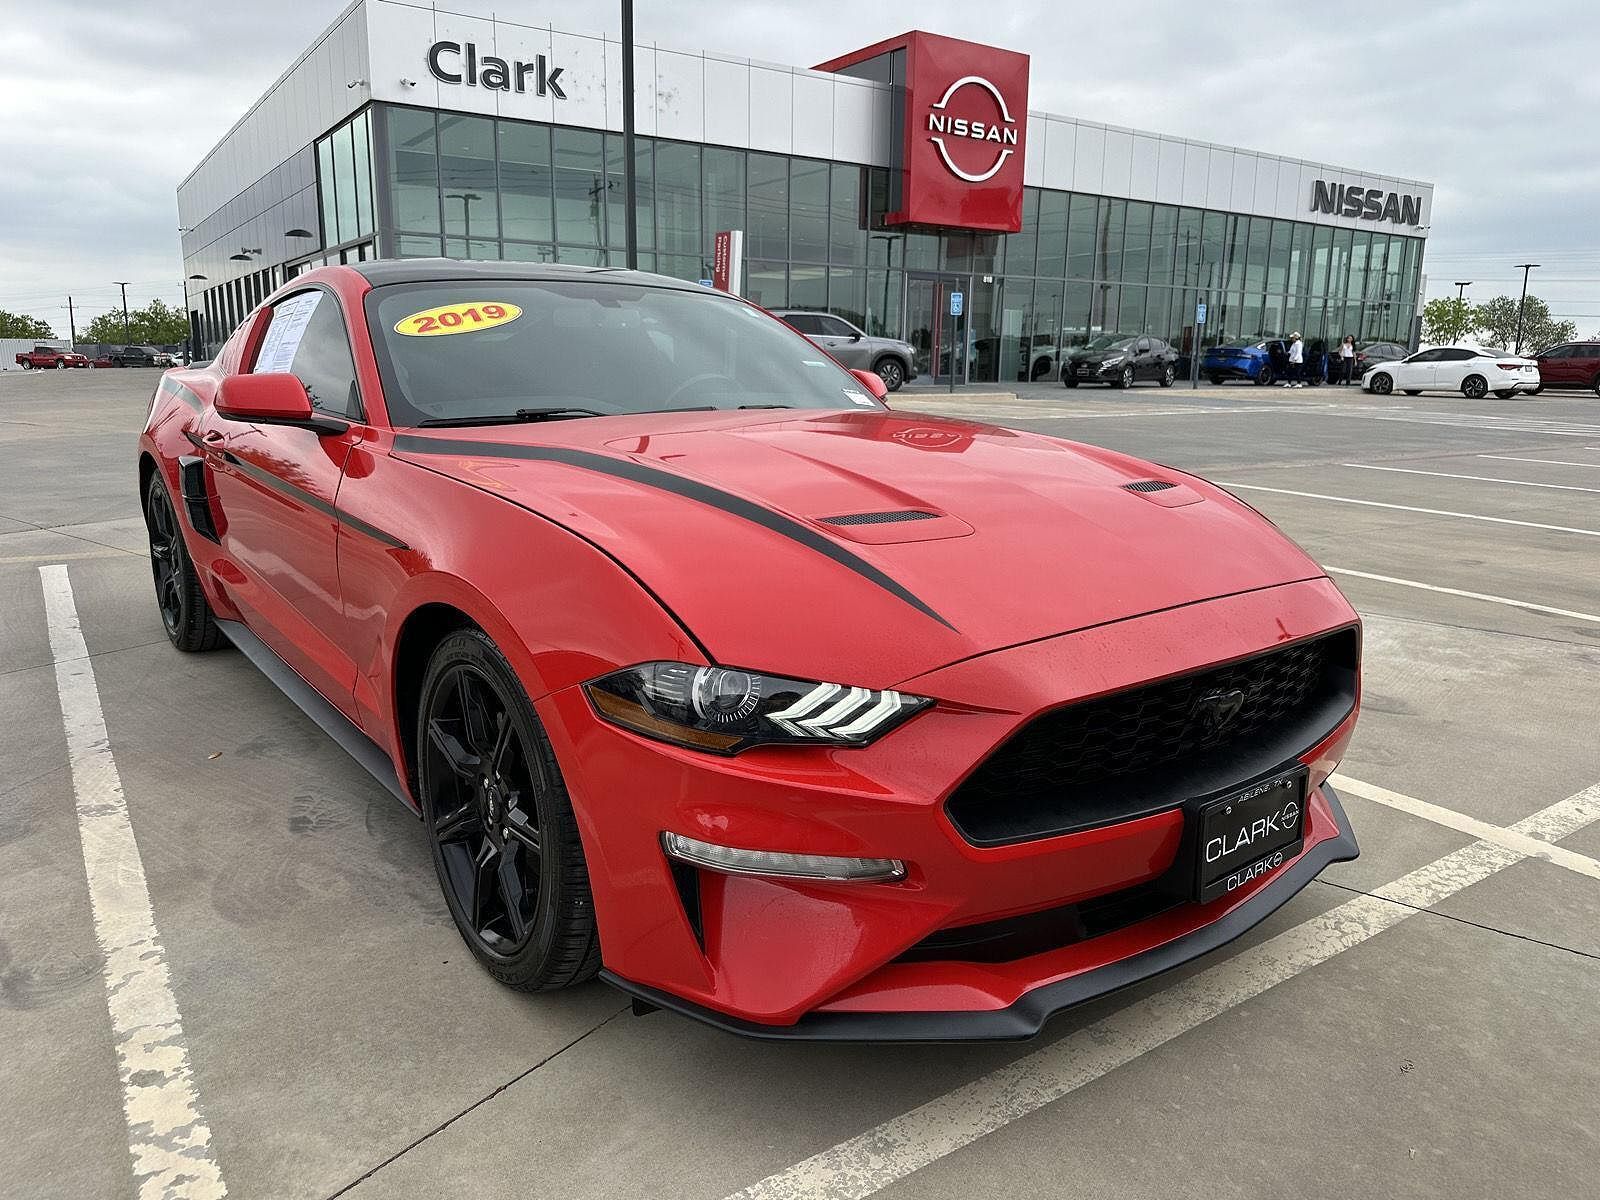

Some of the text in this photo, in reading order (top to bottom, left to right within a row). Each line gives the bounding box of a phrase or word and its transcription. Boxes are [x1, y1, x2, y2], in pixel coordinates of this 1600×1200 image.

[427, 40, 567, 100] Clark
[928, 113, 1018, 145] NISSAN
[1310, 180, 1422, 226] NISSAN
[413, 305, 507, 333] 2019
[1205, 810, 1280, 863] CLARK
[1226, 856, 1274, 892] CLARK
